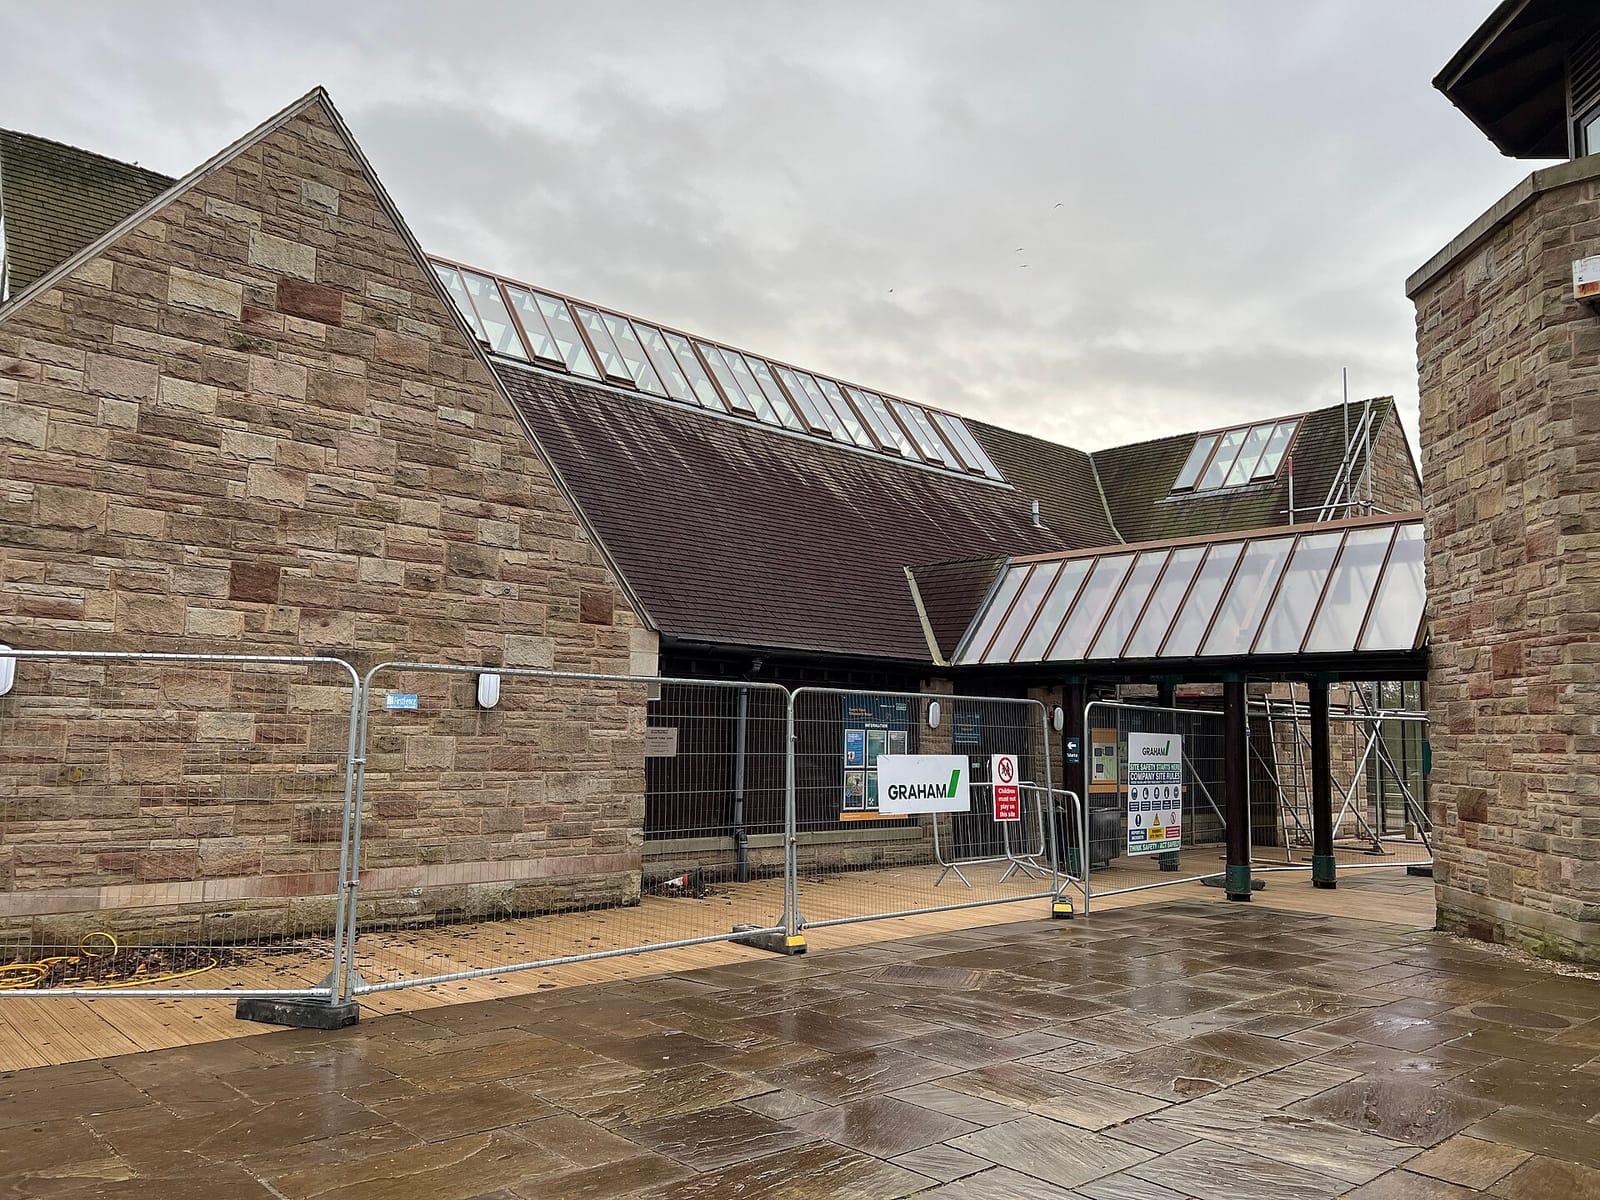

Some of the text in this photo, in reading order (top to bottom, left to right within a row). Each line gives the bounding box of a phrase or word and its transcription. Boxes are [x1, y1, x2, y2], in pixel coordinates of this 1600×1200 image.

[1142, 747, 1166, 756] GRAHAM
[1130, 763, 1139, 771] SITE
[1140, 763, 1156, 771] SAFETY
[1130, 772, 1180, 781] COMPANY SITE RULES
[888, 784, 947, 800] GRAHAM
[1130, 844, 1142, 852] THINK
[1142, 842, 1157, 851] SAFETY
